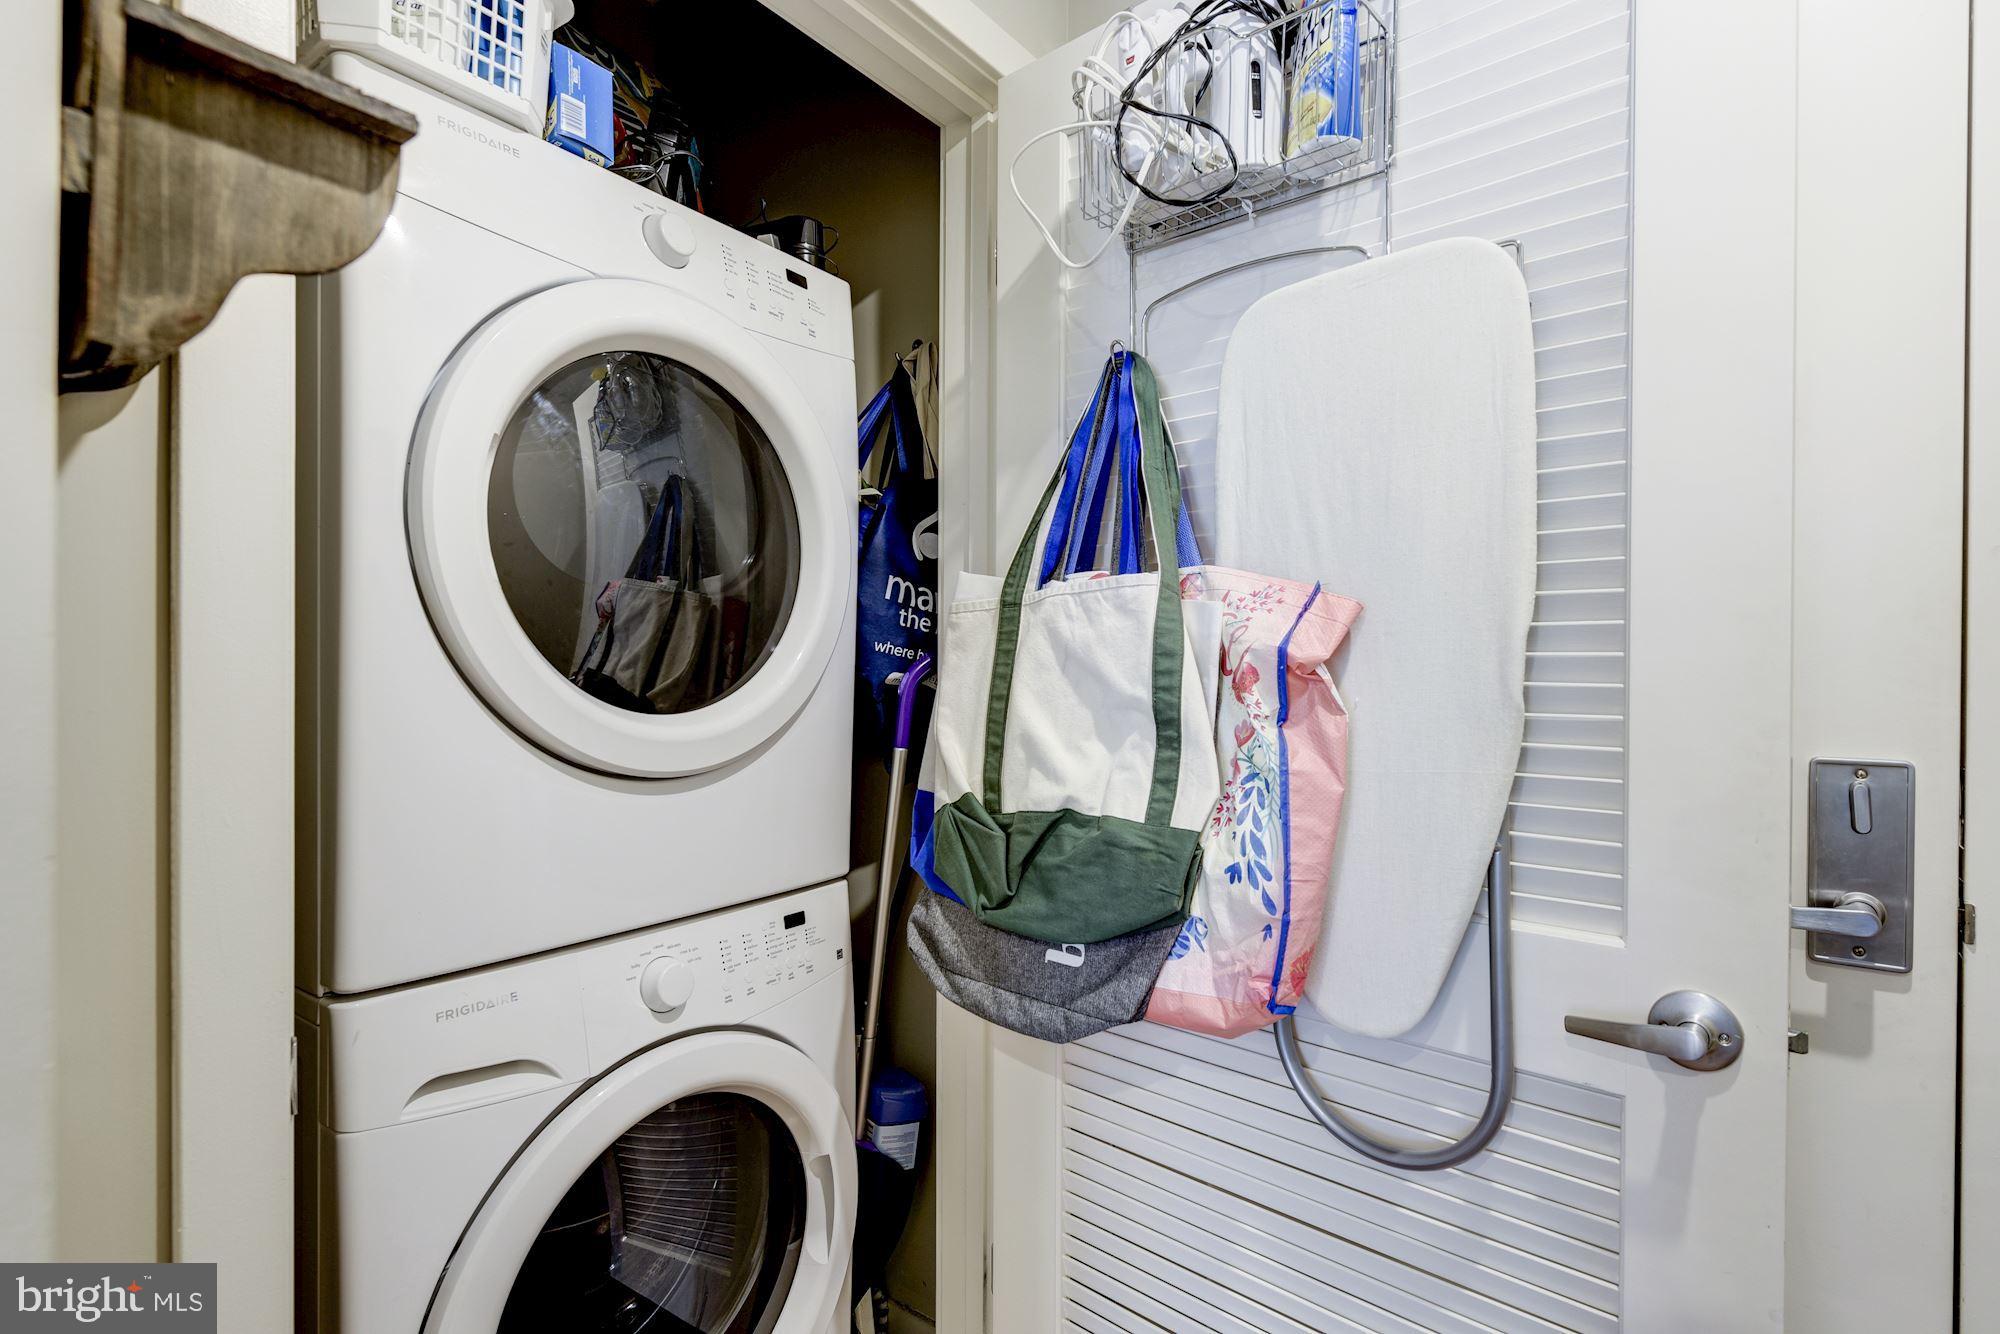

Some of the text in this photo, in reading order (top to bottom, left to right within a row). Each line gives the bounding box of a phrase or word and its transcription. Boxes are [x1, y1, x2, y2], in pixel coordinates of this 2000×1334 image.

[437, 115, 520, 159] FRIGIDAIRE
[899, 607, 931, 632] the
[874, 641, 915, 660] where
[435, 991, 519, 1023] FRIGIDAIRE
